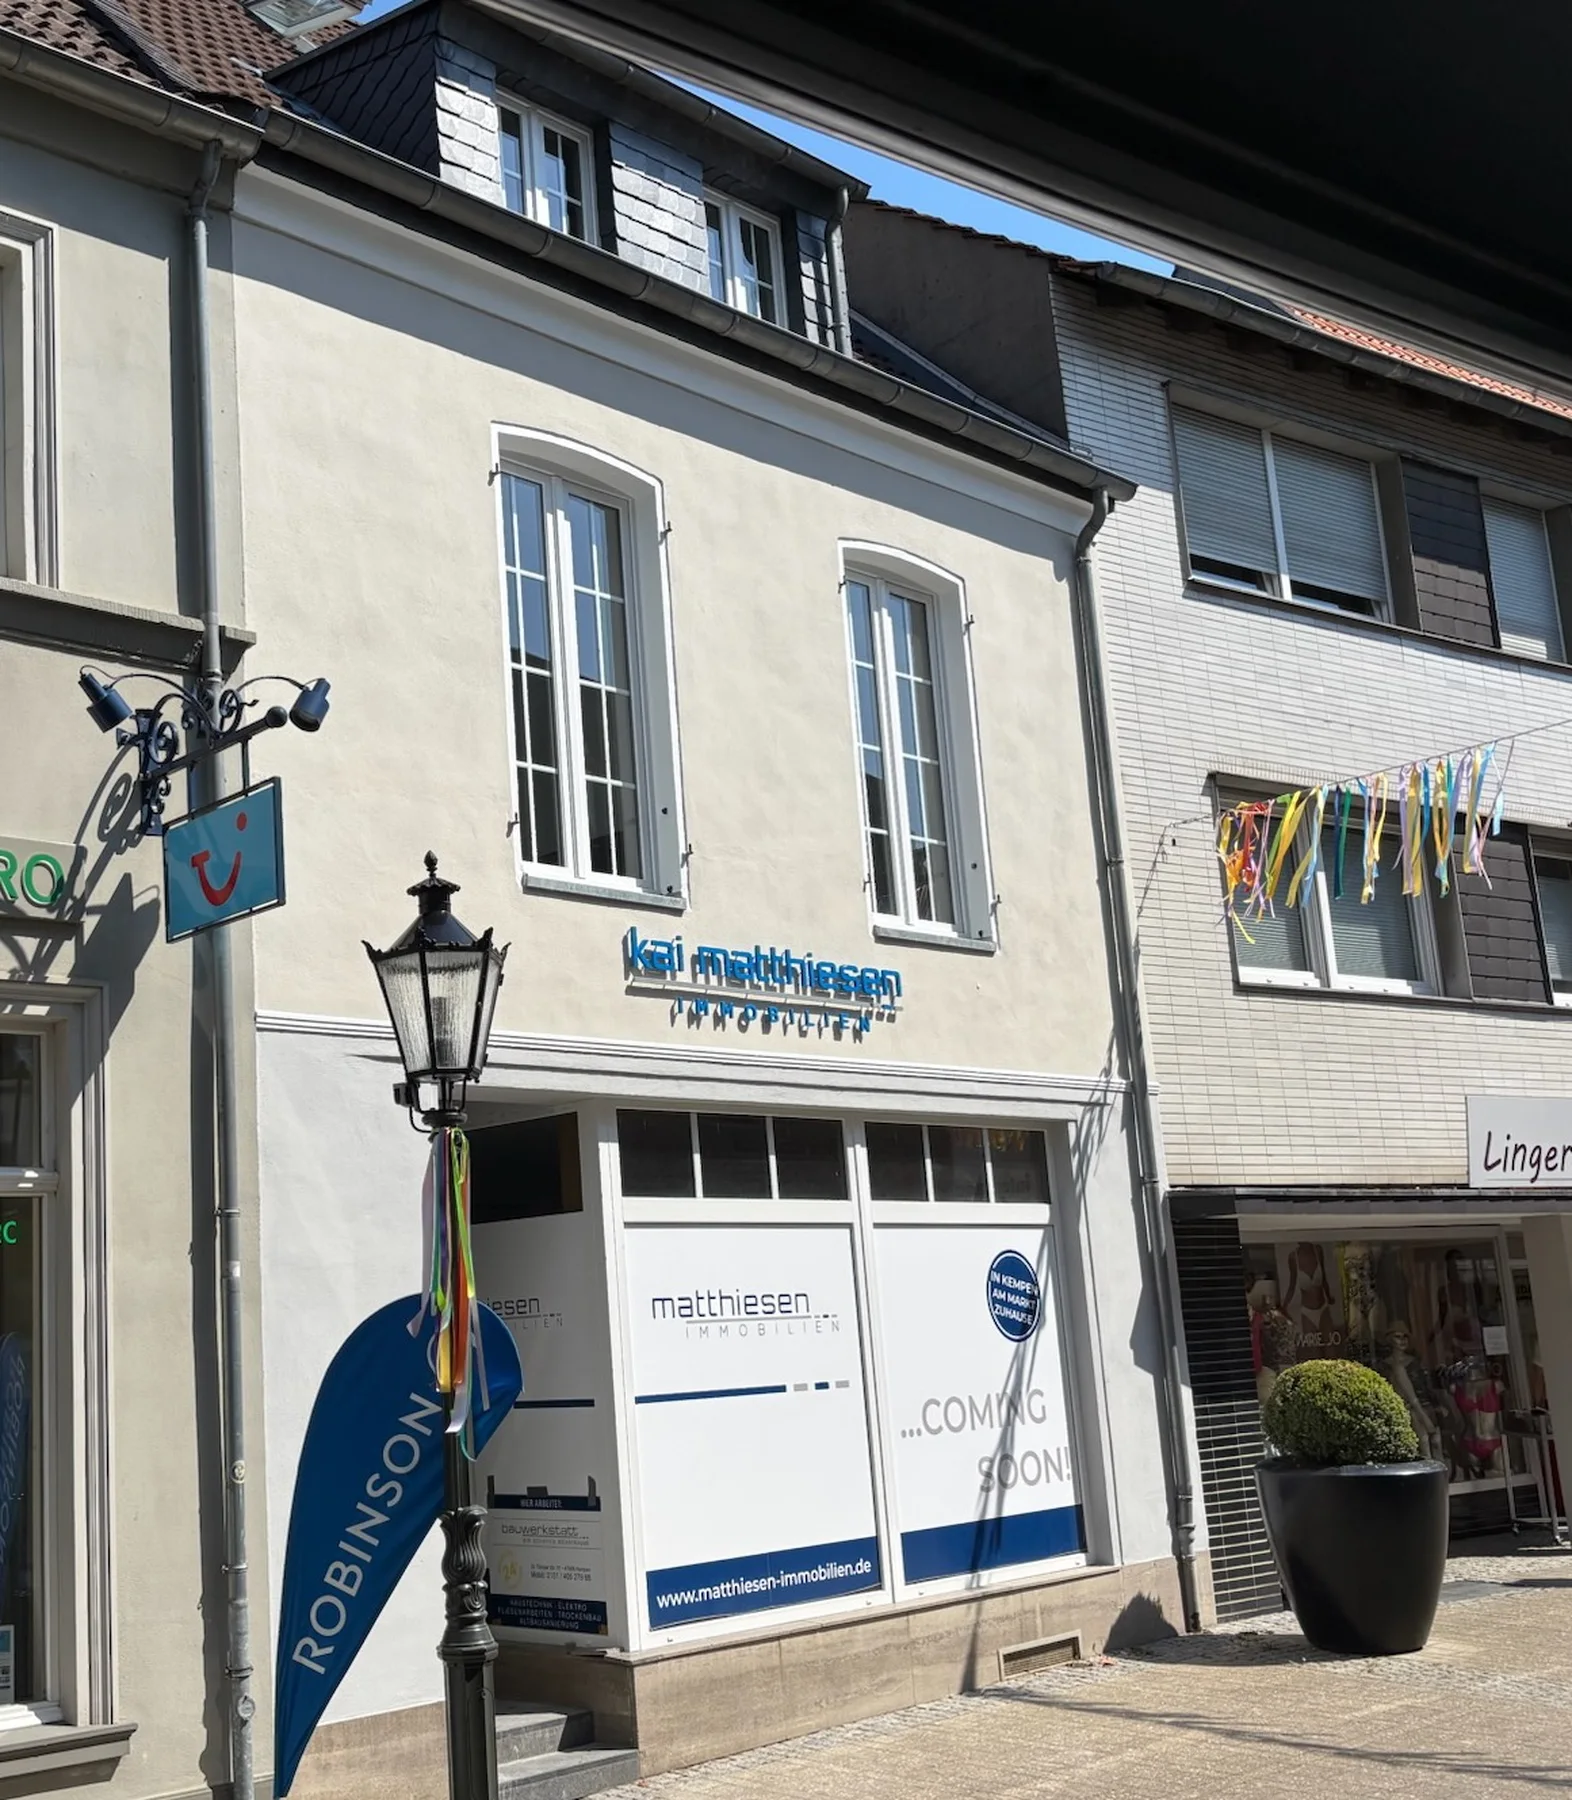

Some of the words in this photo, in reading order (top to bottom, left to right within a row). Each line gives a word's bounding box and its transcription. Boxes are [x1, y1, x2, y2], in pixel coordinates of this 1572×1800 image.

[630, 926, 684, 972] kai
[697, 945, 902, 997] matthiesen
[675, 996, 871, 1032] IMMOBILIEN
[1483, 1130, 1572, 1184] Linger
[990, 1270, 1001, 1284] IN
[1001, 1274, 1039, 1296] KEMPEN
[992, 1288, 1006, 1301] AM
[1007, 1293, 1036, 1310] MARKT
[652, 1288, 810, 1319] matthiesen
[993, 1303, 1033, 1325] ZUHAUSE
[686, 1320, 840, 1339] IMMOBILIEN
[978, 1446, 1072, 1494] SOON!
[292, 1392, 443, 1675] ROBINSON
[656, 1558, 872, 1609] www.matthiesen-immobilien.de
